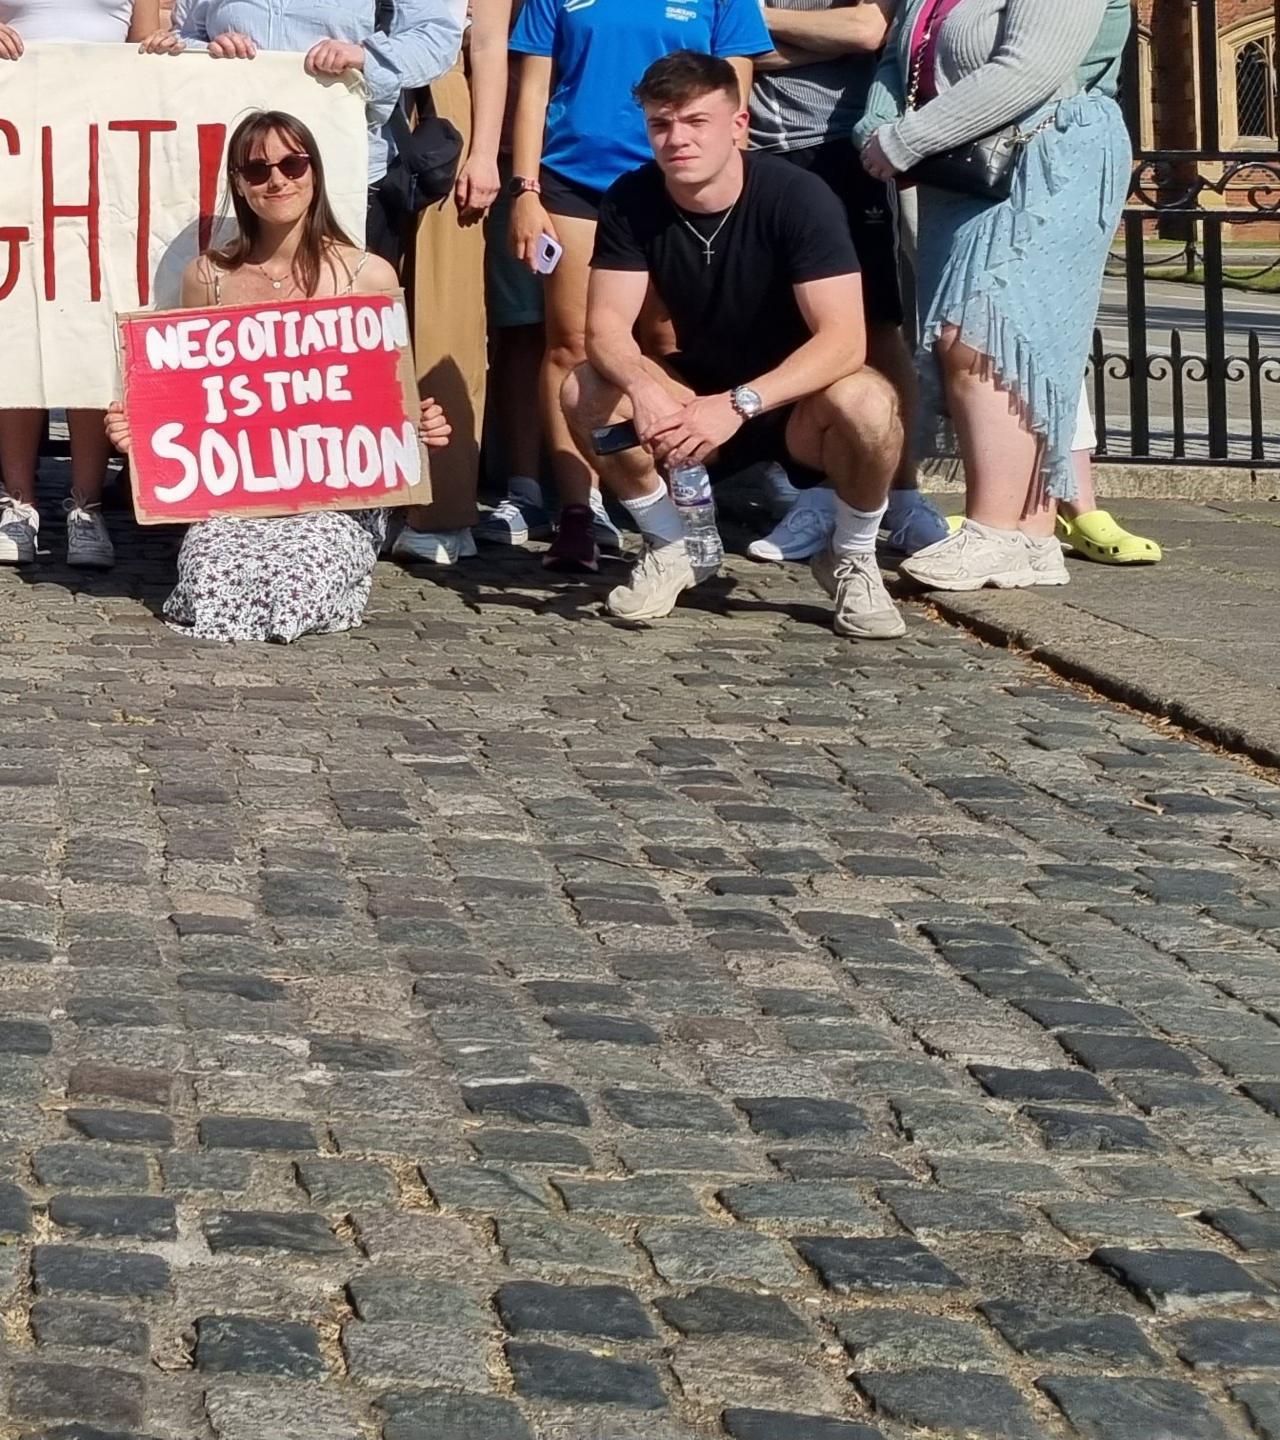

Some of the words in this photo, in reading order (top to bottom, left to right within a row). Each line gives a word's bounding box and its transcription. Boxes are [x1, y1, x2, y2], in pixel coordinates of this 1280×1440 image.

[146, 302, 408, 369] NEGOTIATION
[202, 374, 262, 424] IS
[263, 365, 352, 411] THE
[151, 421, 421, 503] SOLUTION
